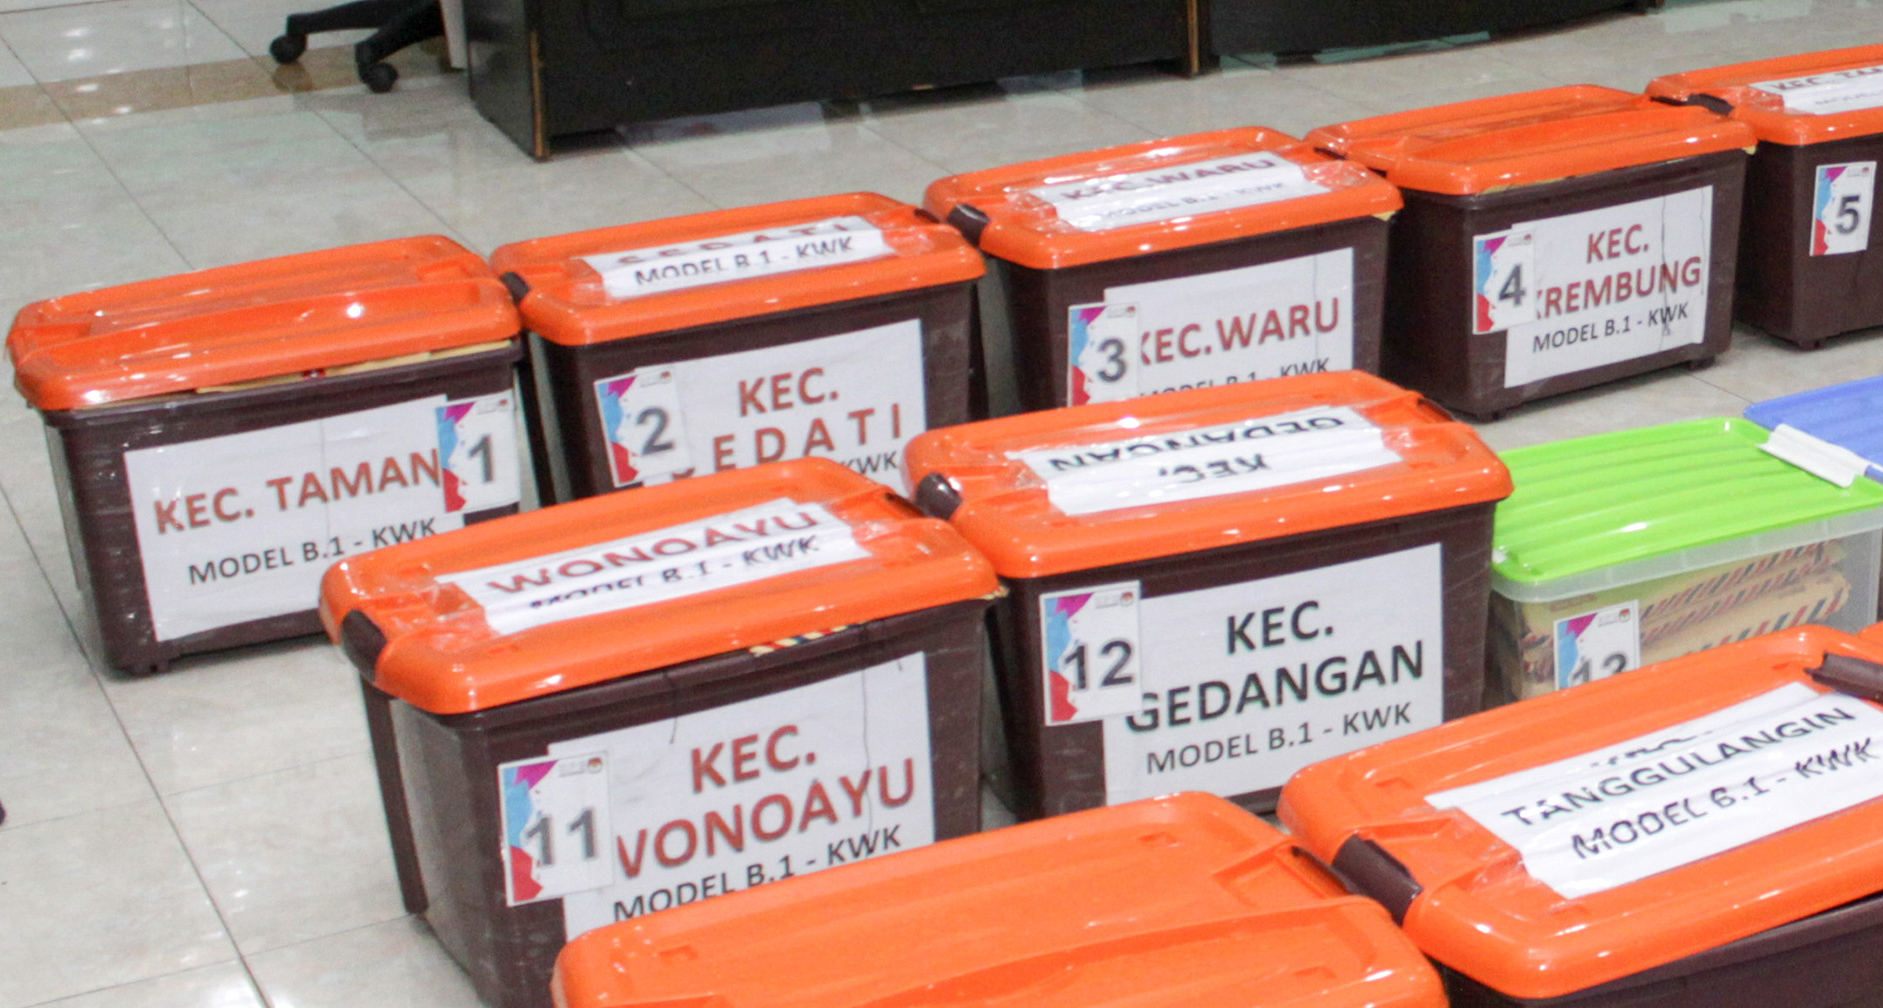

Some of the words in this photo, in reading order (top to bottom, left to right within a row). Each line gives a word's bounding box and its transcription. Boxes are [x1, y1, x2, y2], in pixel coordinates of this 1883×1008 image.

[1835, 194, 1862, 235] 5
[795, 235, 853, 259] KWK
[1584, 221, 1650, 264] KEC.
[1498, 263, 1527, 307] 4
[1097, 338, 1127, 383] 3
[1531, 323, 1599, 354] MODEL
[1604, 314, 1632, 340] B.1
[737, 366, 838, 417] KEC.
[635, 405, 674, 457] 2
[672, 401, 902, 481] EDATI
[466, 434, 495, 484] 1
[153, 485, 255, 535] KEC.
[266, 448, 445, 513] TAMAN
[187, 545, 294, 587] MODEL
[302, 533, 345, 561] B.1
[370, 517, 438, 550] KWK
[486, 512, 818, 594] WONOAYU
[741, 534, 818, 567] KWK
[1226, 600, 1334, 655] KEC.
[1062, 641, 1134, 690] 12
[1125, 639, 1424, 733] GEDANGAN
[691, 724, 816, 794] KEC.
[1145, 732, 1258, 775] MODEL
[1267, 719, 1313, 749] B.1
[1341, 703, 1412, 735] KWK
[1501, 706, 1857, 827] TANGGULANGIN
[1571, 795, 1708, 860] MODEL
[1794, 737, 1881, 780] KWK
[525, 807, 599, 867] 11
[614, 872, 736, 923] MODEL
[747, 844, 796, 887] B.1
[827, 824, 902, 865] KWK
